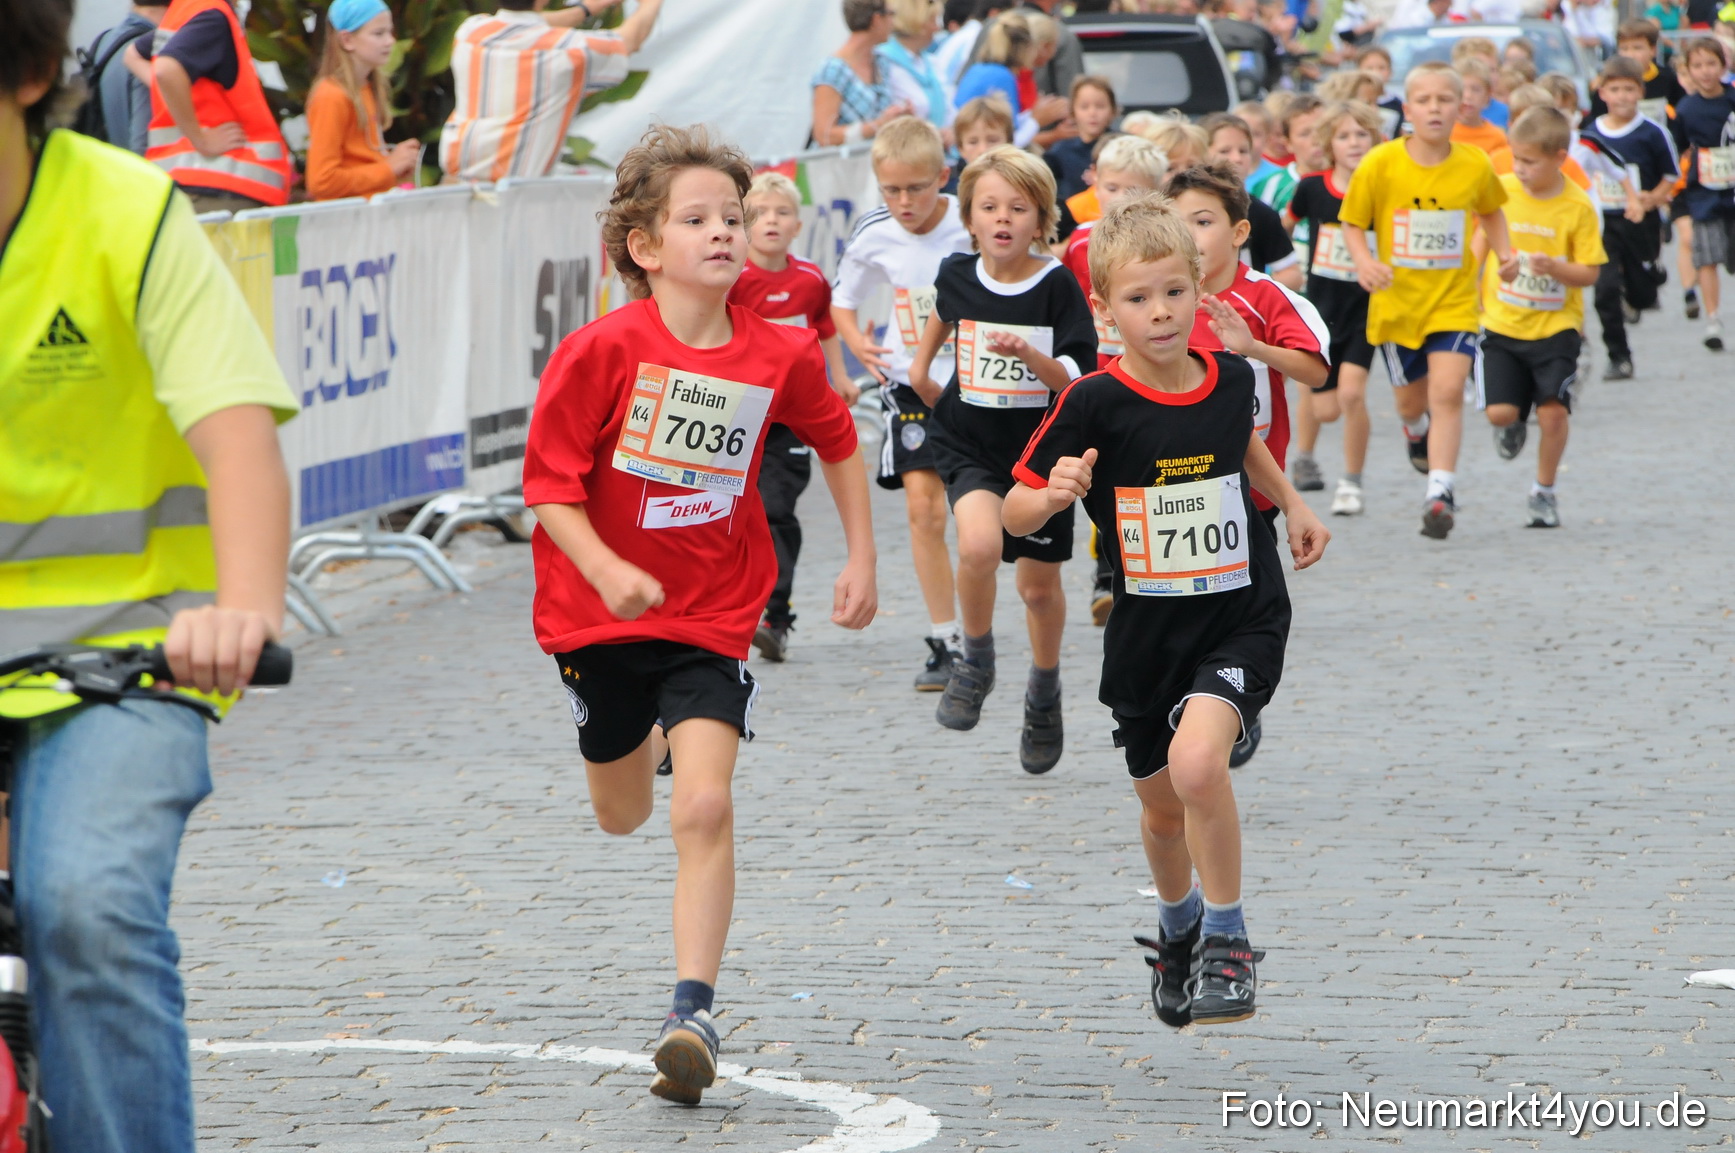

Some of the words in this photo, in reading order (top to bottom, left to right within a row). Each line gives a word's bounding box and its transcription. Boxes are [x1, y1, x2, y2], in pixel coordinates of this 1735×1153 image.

[1413, 232, 1458, 250] 7295
[299, 253, 397, 408] BOCK
[671, 379, 726, 410] Fabian
[631, 404, 649, 423] K4
[665, 414, 746, 457] 7036
[627, 459, 665, 477] BOCK
[1155, 454, 1215, 468] NEUMARKTER
[1160, 464, 1210, 477] STADTLAUF
[696, 472, 743, 488] PFLEIDERER
[669, 500, 713, 518] DEHN
[1153, 494, 1205, 516] Jonas
[1123, 528, 1140, 544] K4
[1157, 519, 1240, 559] 7100
[1137, 581, 1173, 591] BOCK
[1208, 568, 1248, 586] PFLEIDERER
